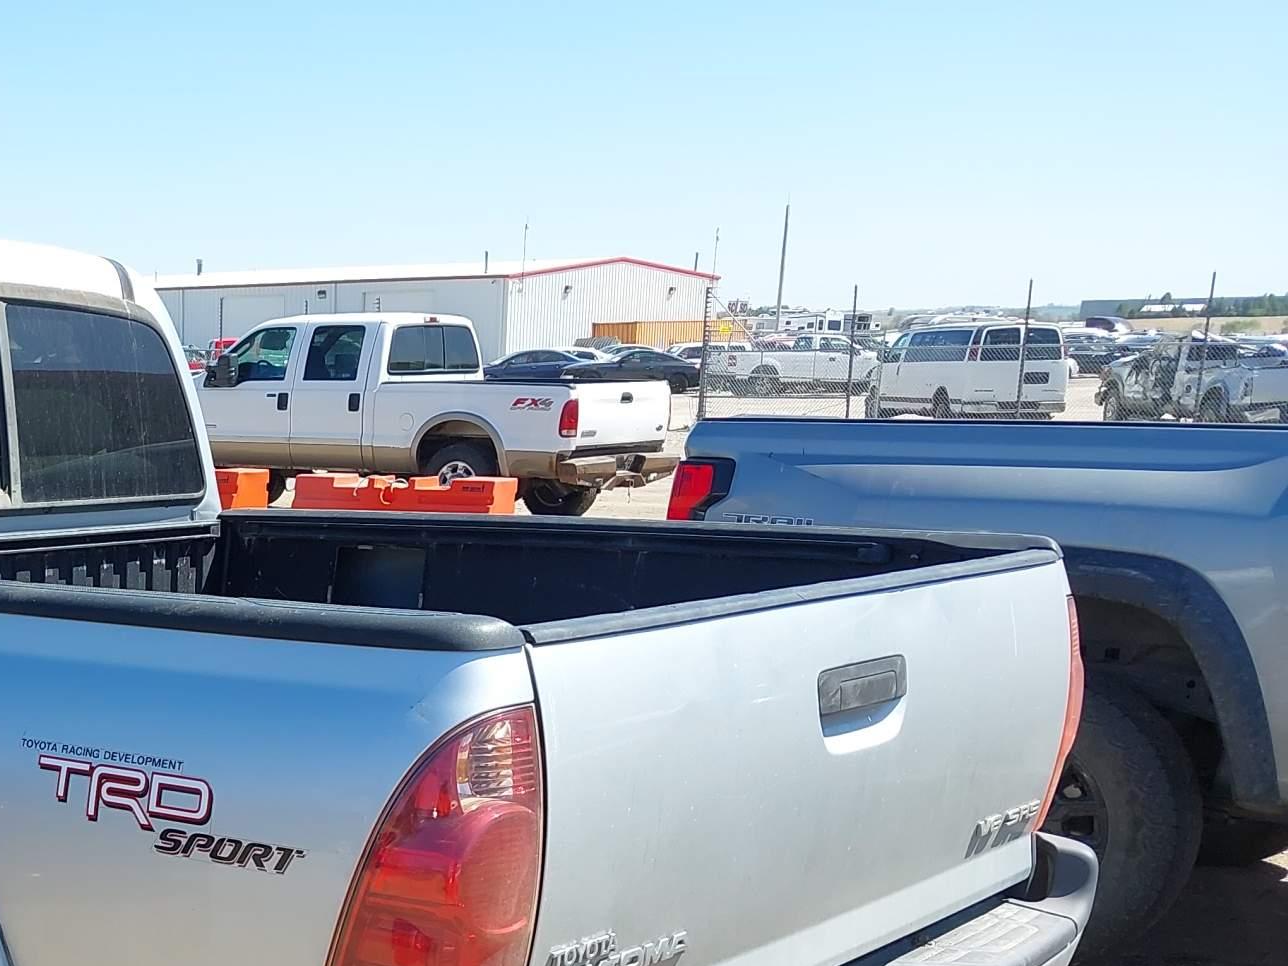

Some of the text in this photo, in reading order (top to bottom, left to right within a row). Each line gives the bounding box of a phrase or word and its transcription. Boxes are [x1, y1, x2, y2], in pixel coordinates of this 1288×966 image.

[511, 397, 554, 407] FX4
[21, 738, 184, 771] TOYOTA RACING DEVELOPMENT
[38, 754, 215, 833] TRD
[153, 828, 309, 875] SPORT
